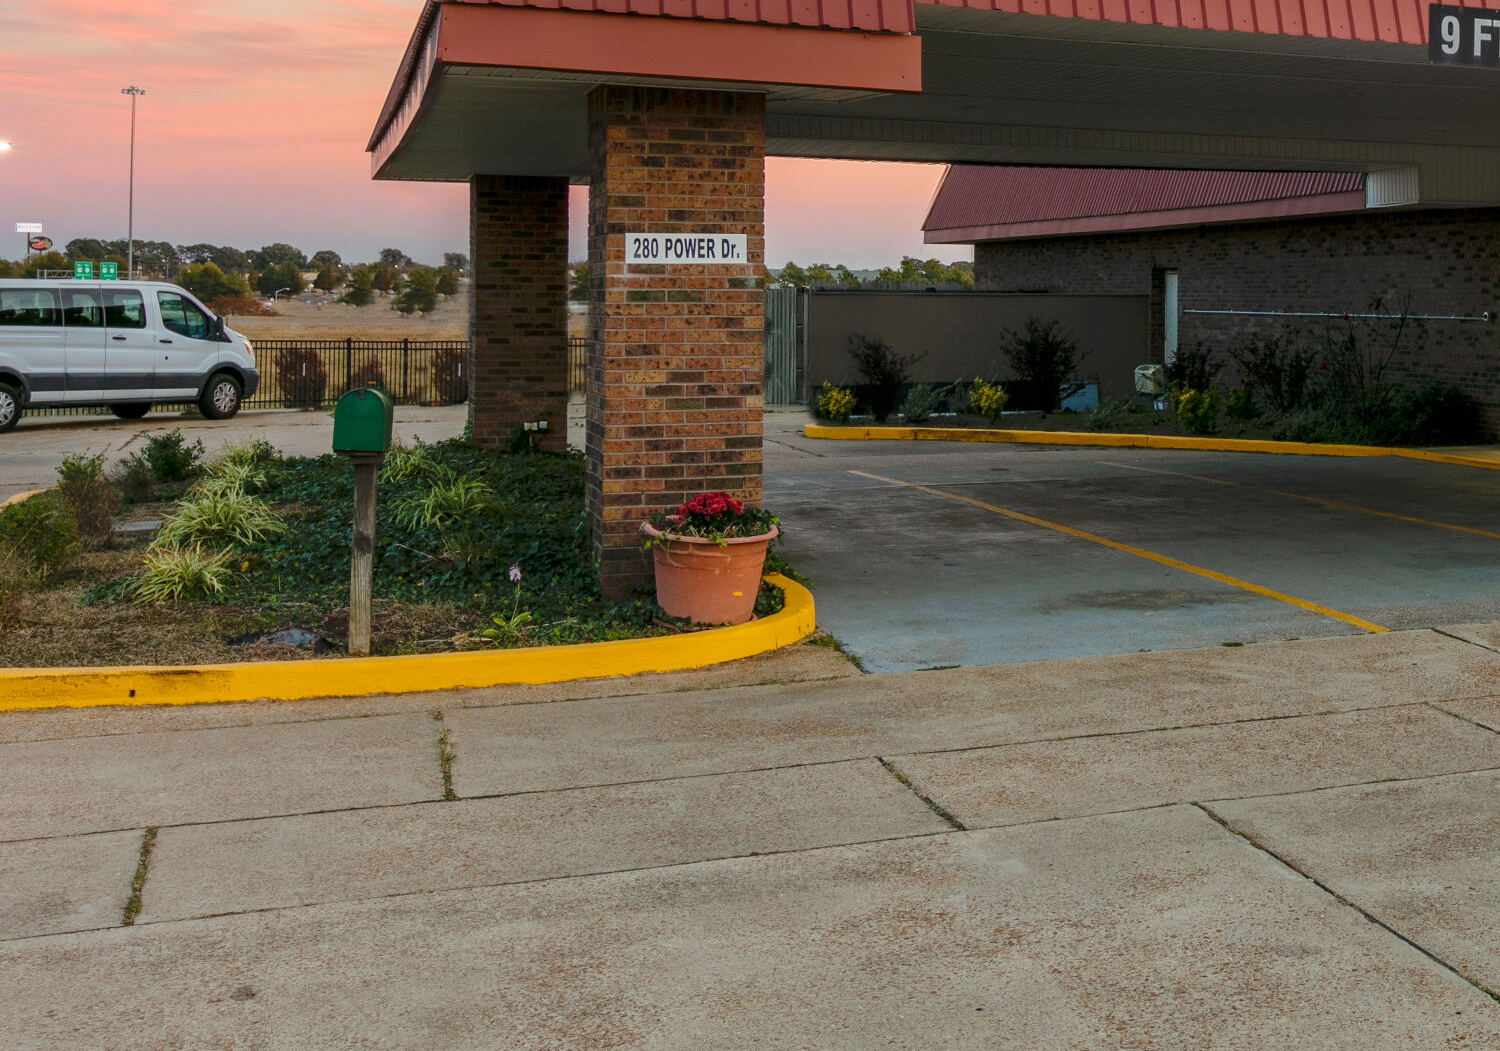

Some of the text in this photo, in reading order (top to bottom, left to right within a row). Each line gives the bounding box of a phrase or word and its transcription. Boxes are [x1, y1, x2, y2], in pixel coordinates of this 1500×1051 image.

[1441, 15, 1460, 55] 9
[633, 237, 740, 259] 280 POWER Dr.
